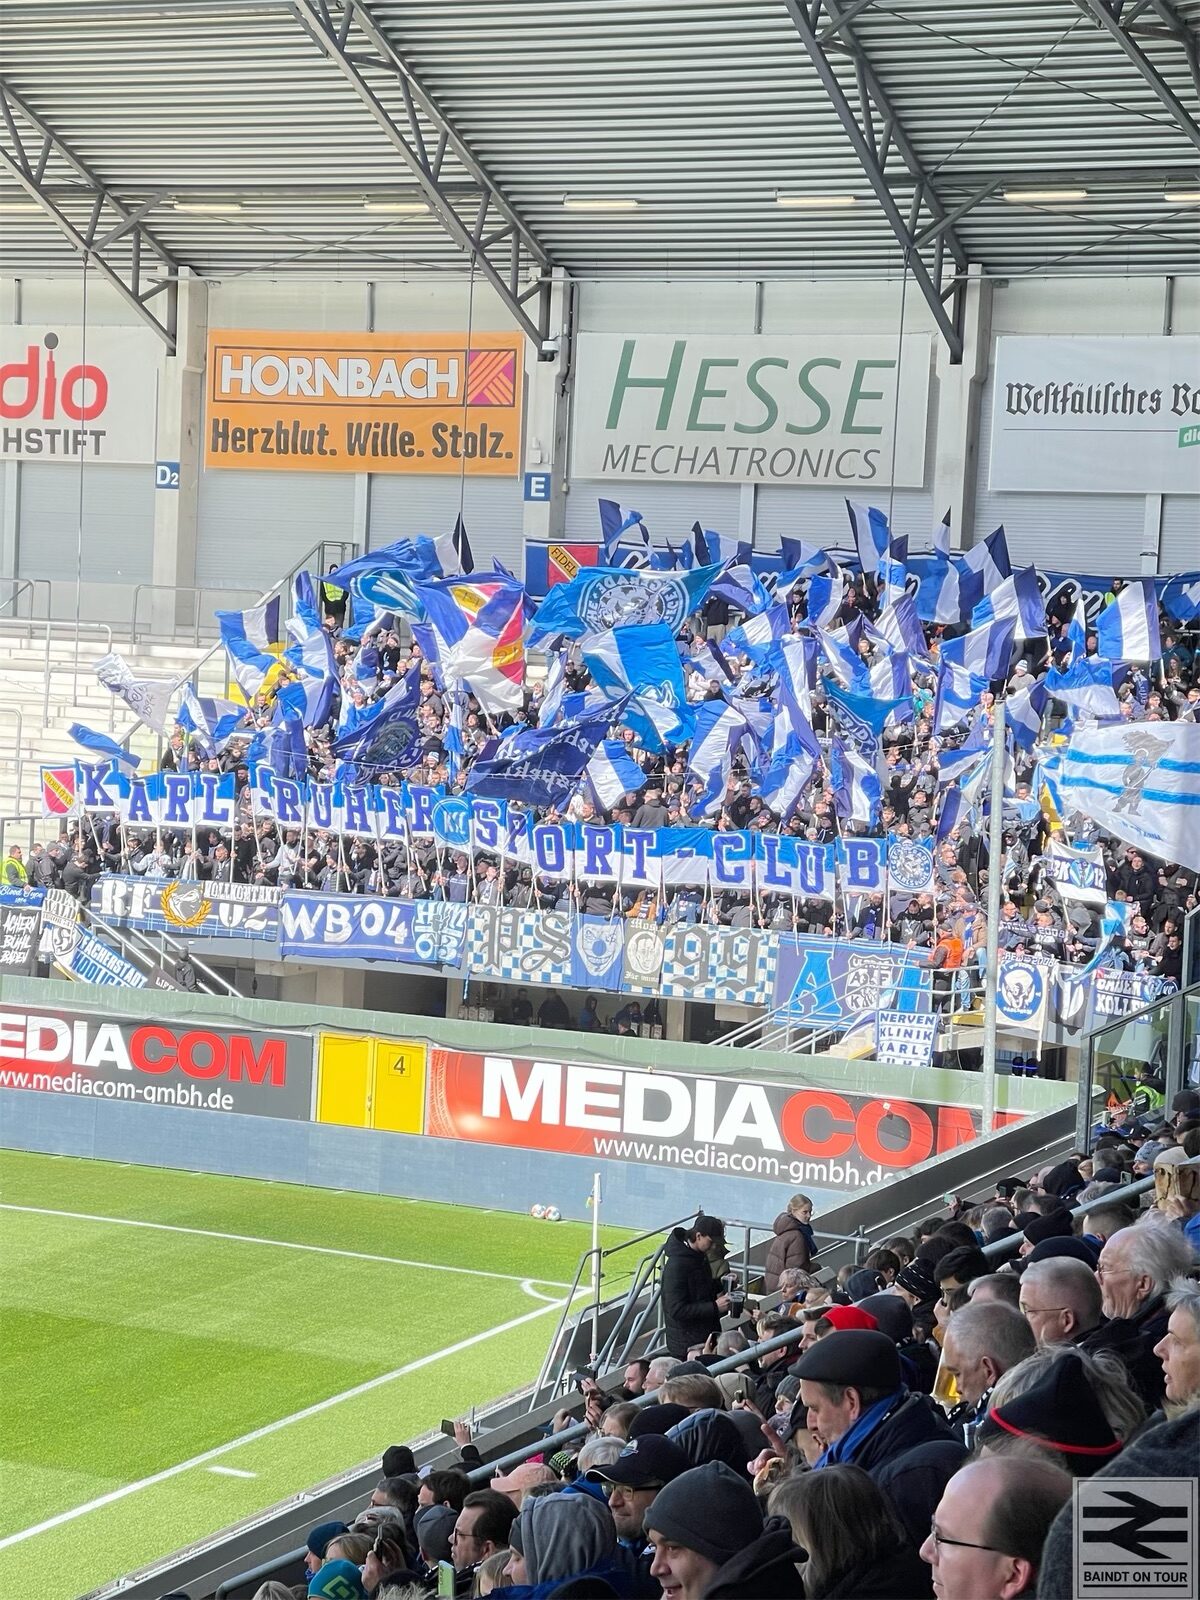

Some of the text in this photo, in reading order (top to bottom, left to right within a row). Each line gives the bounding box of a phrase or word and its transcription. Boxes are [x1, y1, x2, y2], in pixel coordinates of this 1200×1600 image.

[220, 354, 460, 400] HORNBACH
[605, 340, 897, 435] HESSE
[3, 427, 107, 456] HSTIFT
[212, 418, 514, 460] Herzblut. Wille. Stolz.
[1184, 428, 1200, 444] di
[602, 444, 881, 480] MECHATRONICS
[156, 465, 179, 489] D2
[530, 475, 546, 498] E
[551, 547, 578, 577] FIDEL
[70, 950, 131, 987] HOOLIG
[879, 1012, 935, 1026] NERVEN
[394, 1055, 406, 1075] 4
